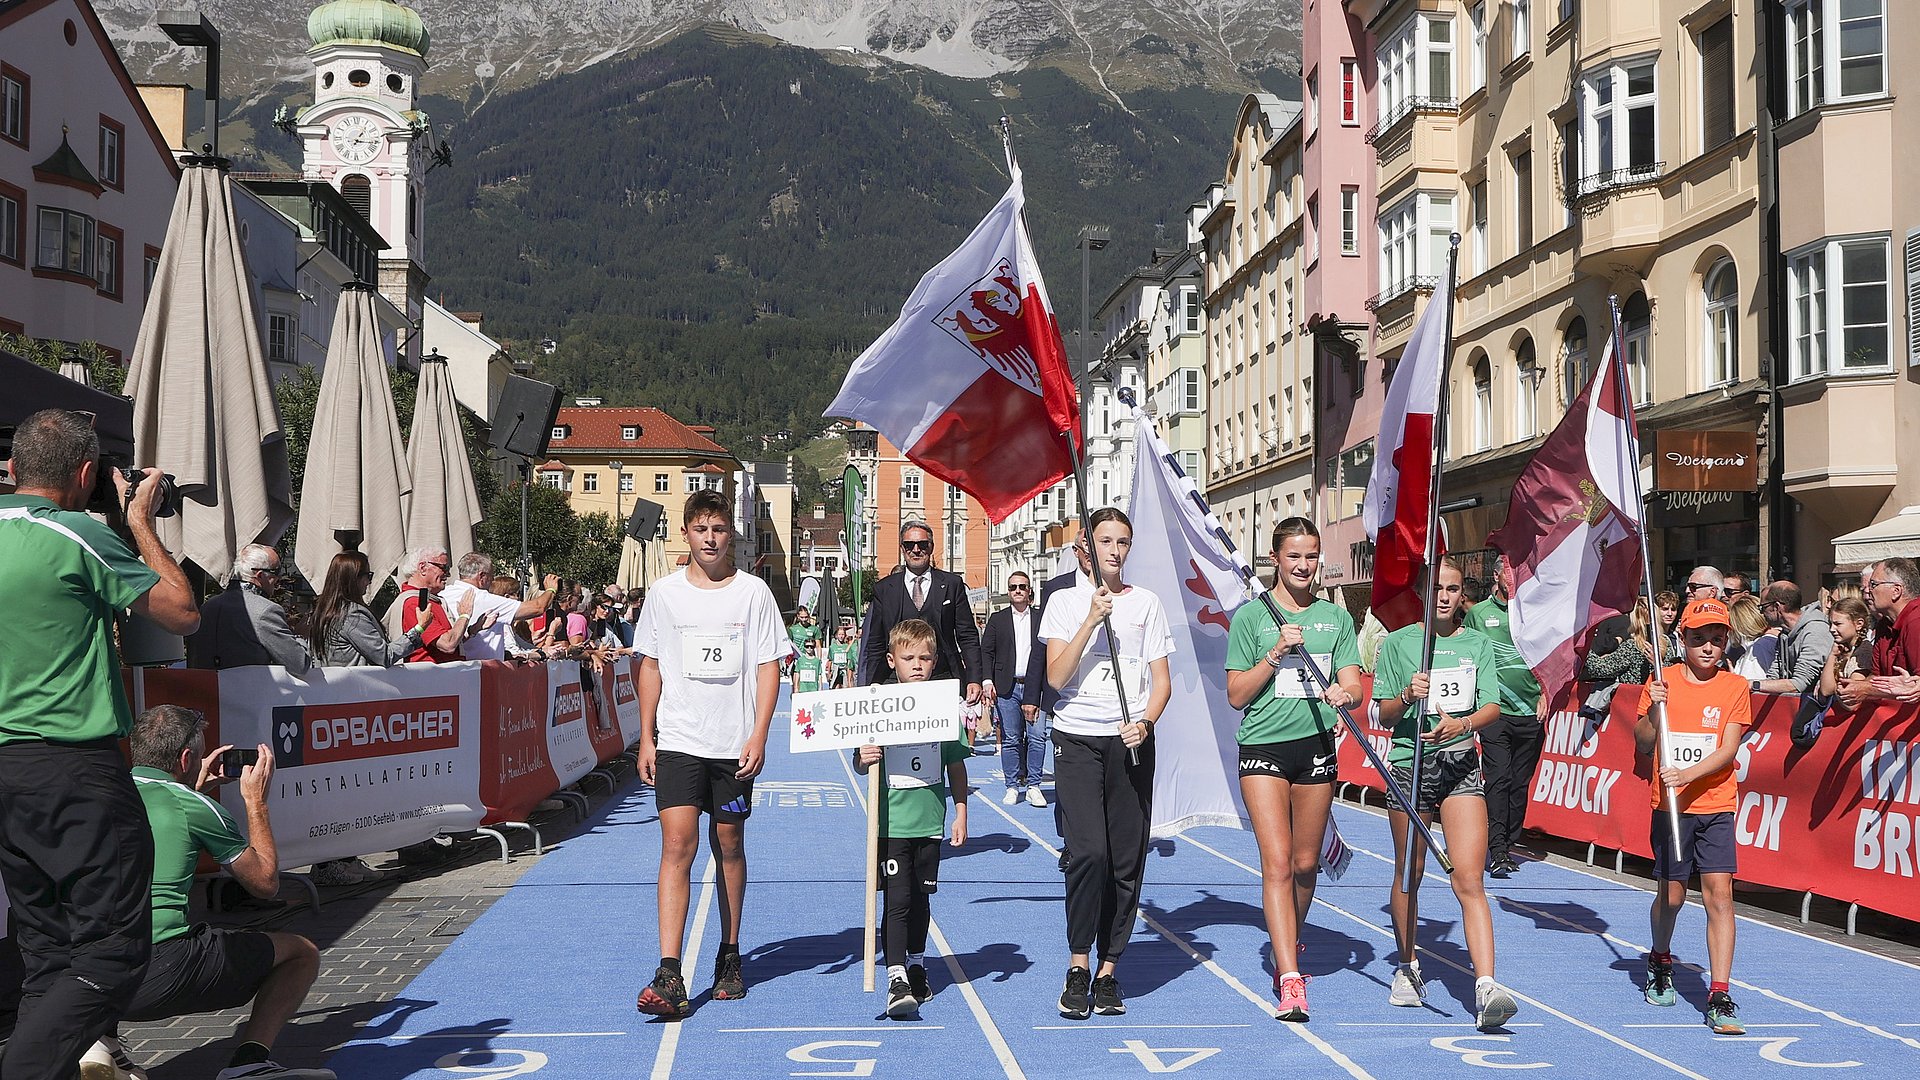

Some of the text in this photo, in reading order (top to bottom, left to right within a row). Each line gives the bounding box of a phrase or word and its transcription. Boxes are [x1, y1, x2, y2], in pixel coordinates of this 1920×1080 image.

[1665, 451, 1749, 470] Weigand
[701, 647, 723, 662] 78
[1440, 682, 1460, 698] 33
[834, 695, 916, 717] EUREGIO
[310, 709, 454, 750] OPBACHER
[833, 717, 949, 739] SprintChampion
[910, 756, 922, 772] 6
[1674, 747, 1702, 763] 109
[281, 760, 453, 799] INSTALLATEURE
[1533, 760, 1622, 816] BRUCK
[309, 821, 328, 839] 6263
[329, 820, 351, 836] Fügen
[355, 815, 373, 829] 6100
[373, 811, 396, 827] Seefeld
[1735, 791, 1788, 852] CK
[881, 858, 899, 877] 10
[784, 1040, 882, 1077] 5
[1108, 1039, 1222, 1073] 4
[1430, 1035, 1555, 1069] 3
[1711, 1036, 1865, 1067] 2
